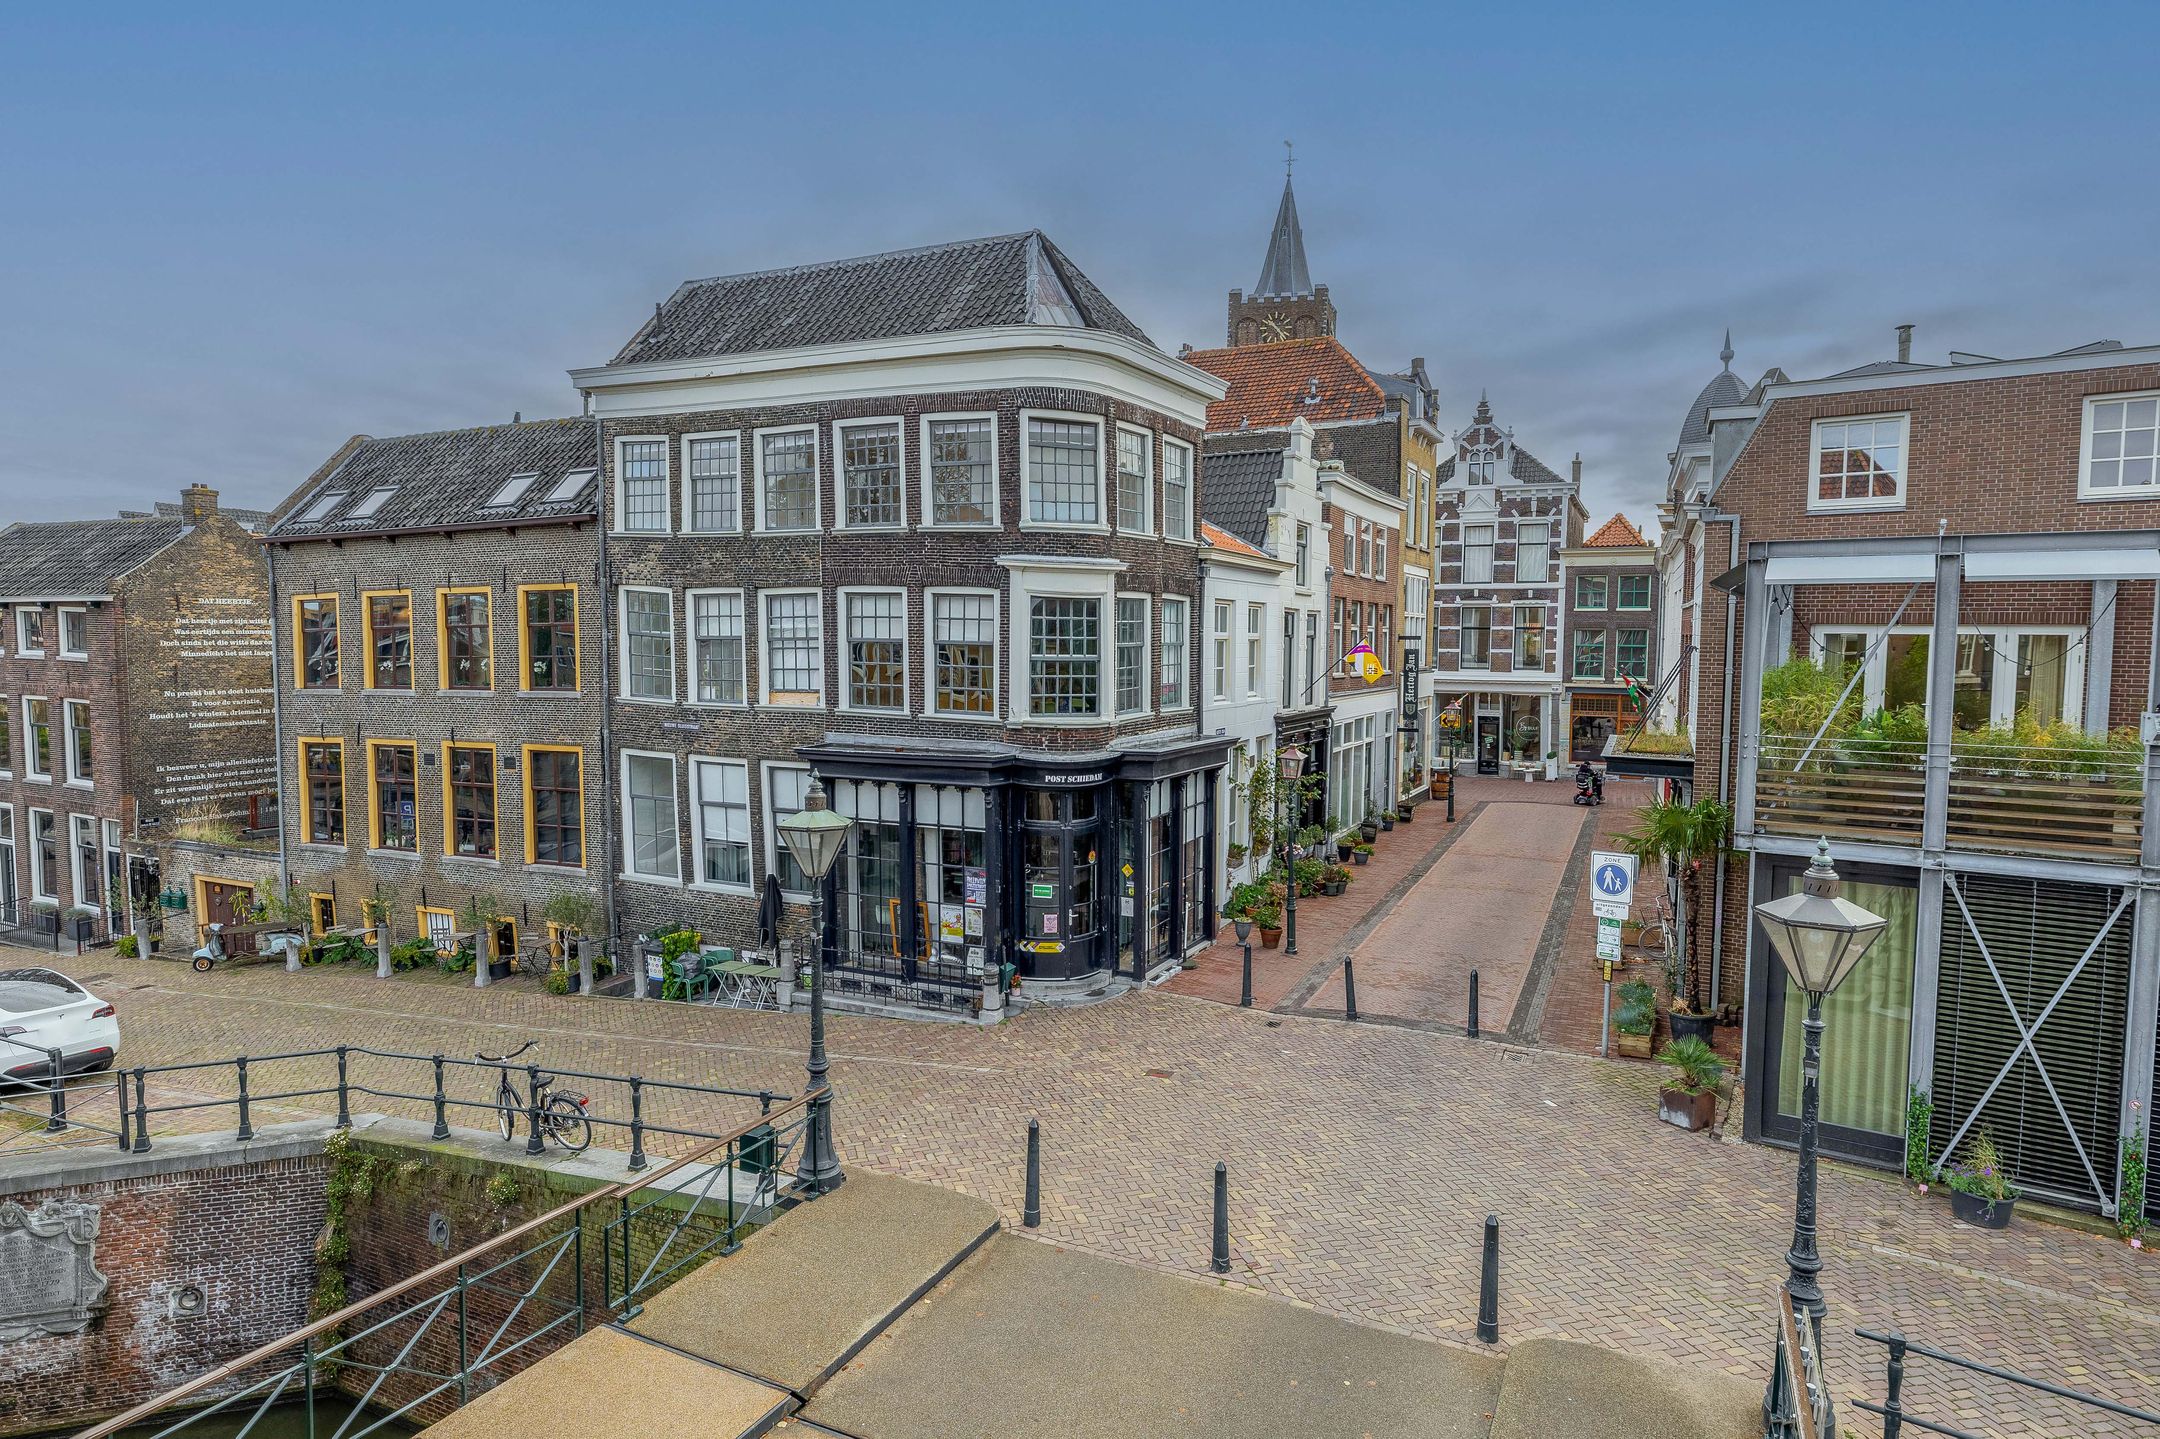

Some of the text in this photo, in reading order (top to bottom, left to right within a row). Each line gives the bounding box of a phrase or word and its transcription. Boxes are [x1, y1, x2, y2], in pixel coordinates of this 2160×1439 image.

[235, 618, 248, 626] zijn
[1405, 653, 1417, 702] Hertog Jan
[164, 690, 175, 698] Nu
[177, 689, 202, 698] preekt
[149, 712, 174, 720] Houdt
[230, 708, 262, 716] driemaal
[156, 764, 165, 772] Ik
[167, 763, 198, 772] bezweer
[208, 761, 225, 769] mijn
[226, 756, 264, 766] allerliefste
[166, 775, 182, 783] Den
[183, 773, 205, 782] draak
[207, 771, 223, 780] hier
[224, 769, 239, 777] niet
[1045, 772, 1103, 783] POST SCHIEDAM
[154, 787, 164, 795] Er
[165, 785, 176, 794] zit
[177, 782, 214, 792] wezenlijk
[215, 781, 228, 789] zoo
[229, 779, 243, 788] iets
[161, 798, 175, 806] Dat
[41, 1279, 60, 1287] 1779
